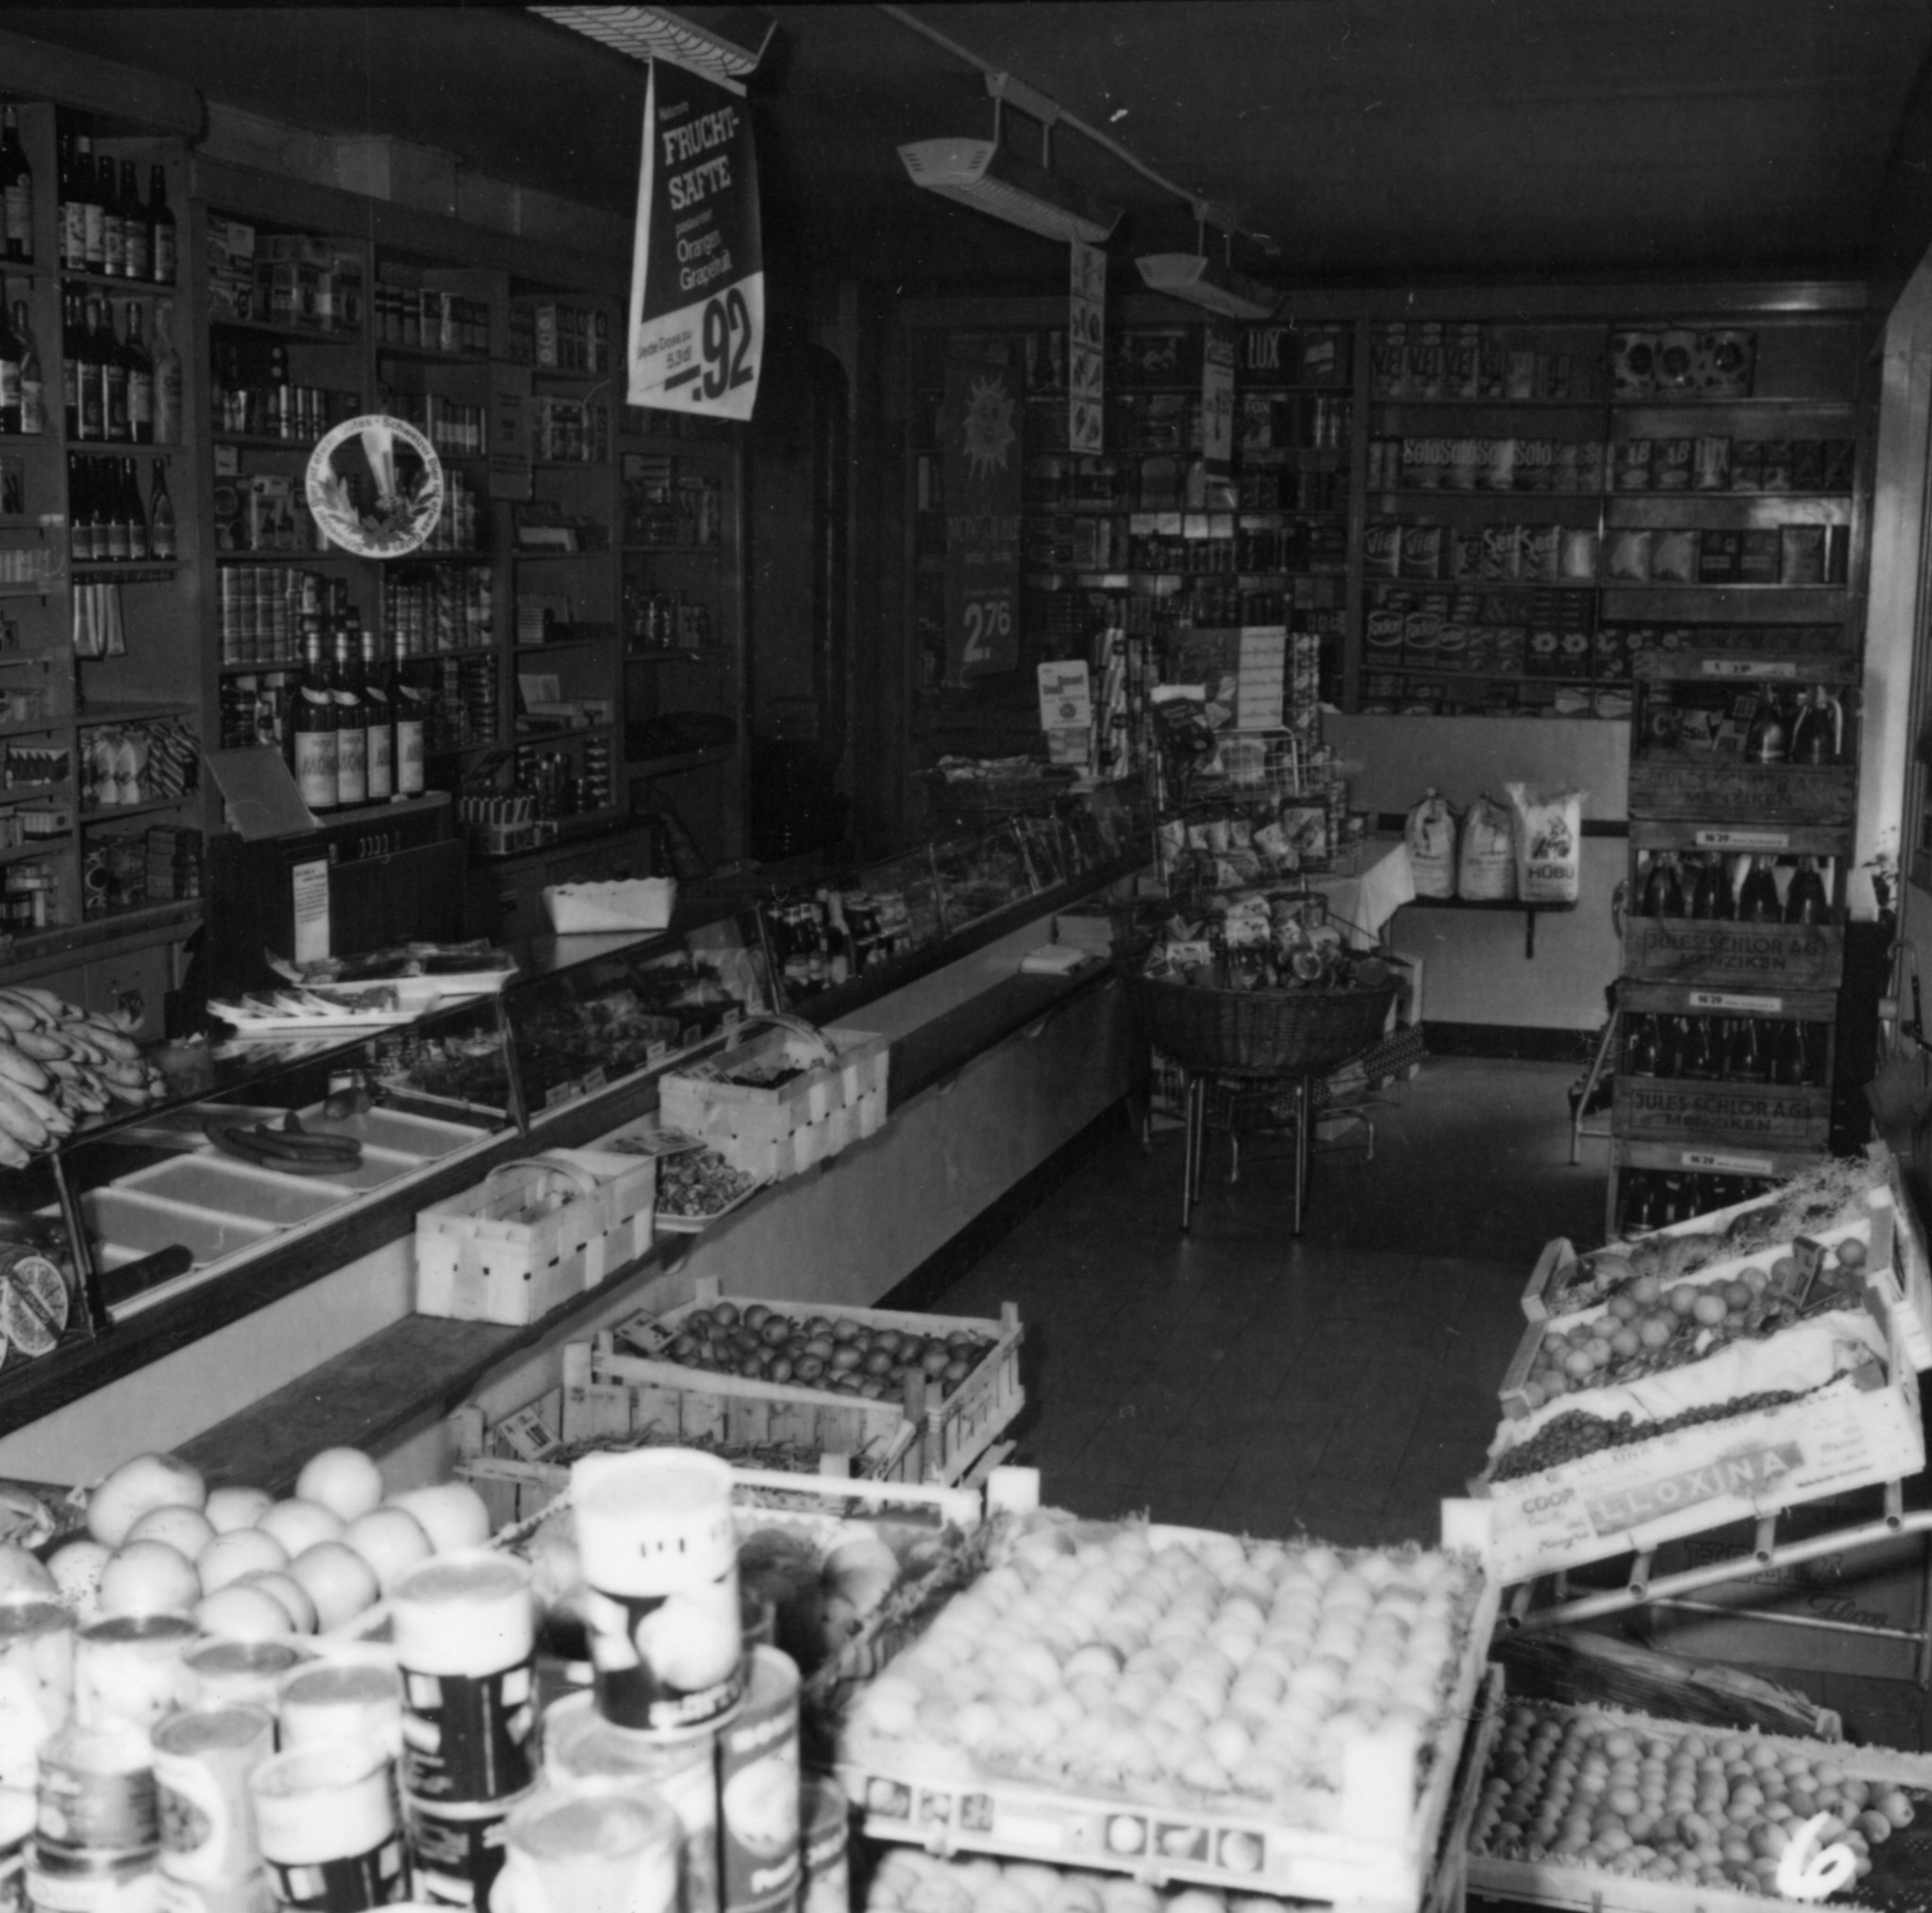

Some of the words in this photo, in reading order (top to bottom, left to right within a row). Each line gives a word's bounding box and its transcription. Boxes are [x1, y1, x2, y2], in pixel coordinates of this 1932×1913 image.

[661, 106, 740, 166] FRUCHT-
[1248, 331, 1280, 369] LUX
[1635, 1094, 1688, 1111] JULES
[1602, 1451, 1789, 1522] LLOXINA
